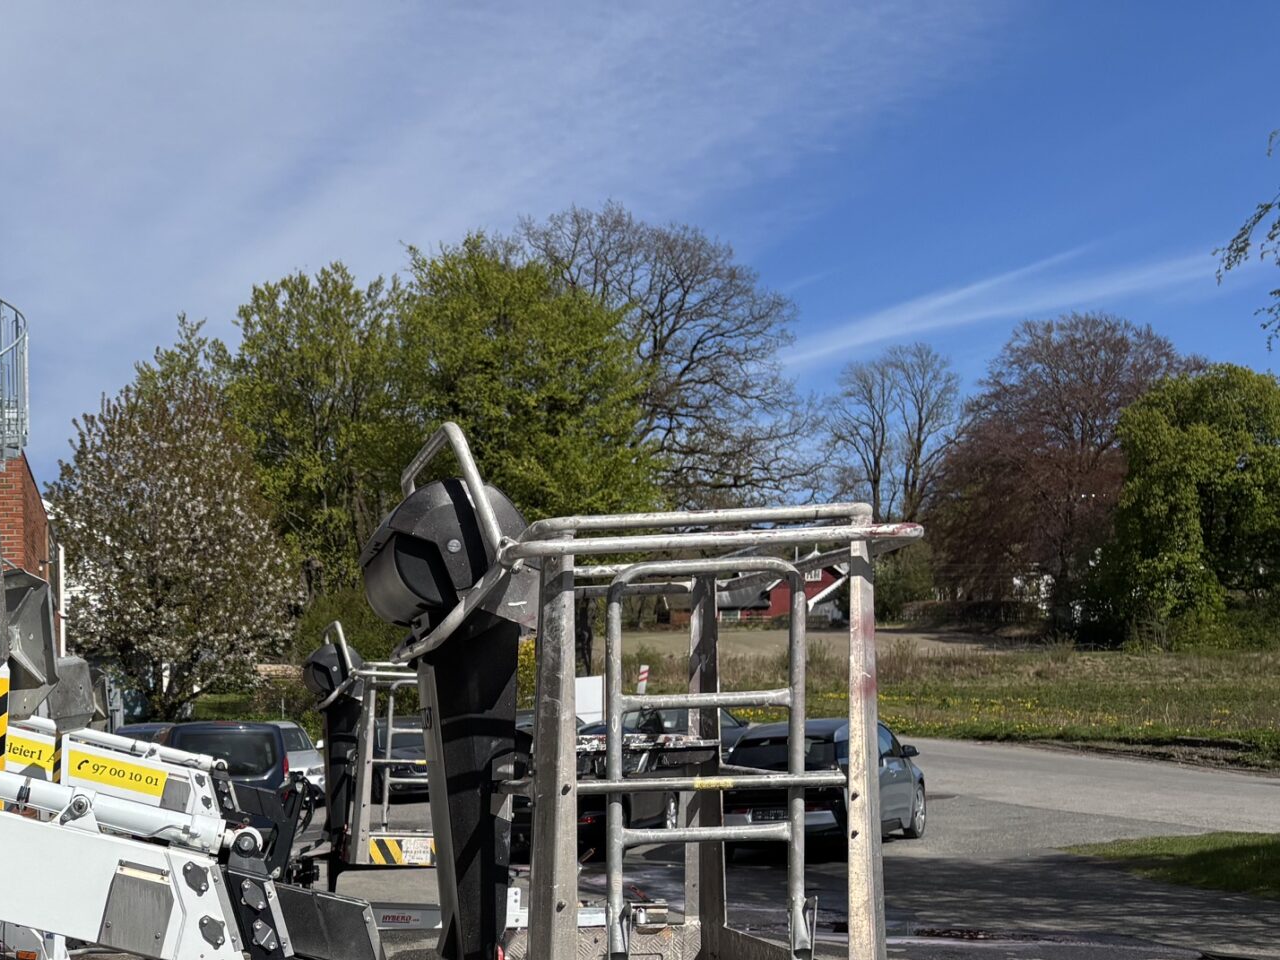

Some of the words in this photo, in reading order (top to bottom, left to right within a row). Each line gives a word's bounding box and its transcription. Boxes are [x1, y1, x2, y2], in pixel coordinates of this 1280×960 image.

[6, 742, 42, 761] leier1
[92, 763, 107, 775] 97
[109, 767, 125, 778] 00
[128, 771, 142, 782] 10
[145, 775, 159, 786] 01
